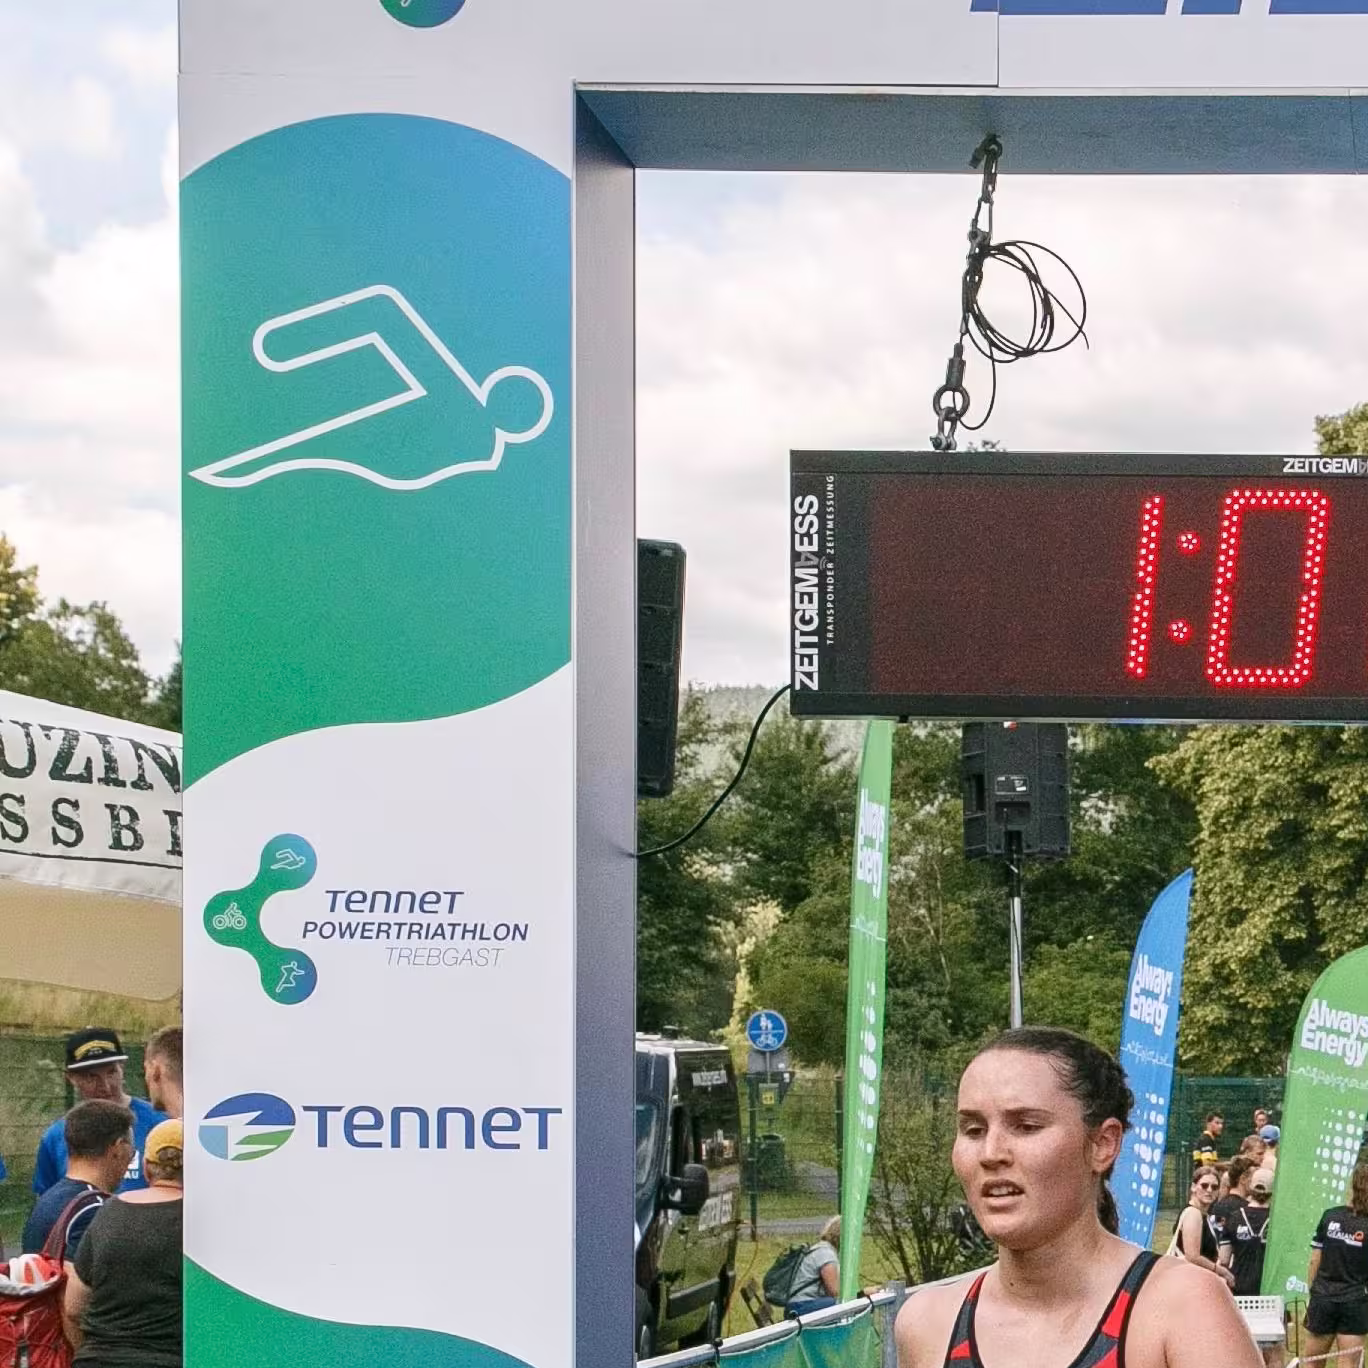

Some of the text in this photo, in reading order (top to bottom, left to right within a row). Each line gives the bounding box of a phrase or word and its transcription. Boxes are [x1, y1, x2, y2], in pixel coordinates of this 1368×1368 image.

[826, 475, 835, 646] TRANSPONDER ZEITMESSUNG
[302, 921, 529, 942] POWERTRIATHLON
[385, 946, 505, 967] TREBGAST
[1130, 990, 1169, 1035] Energy
